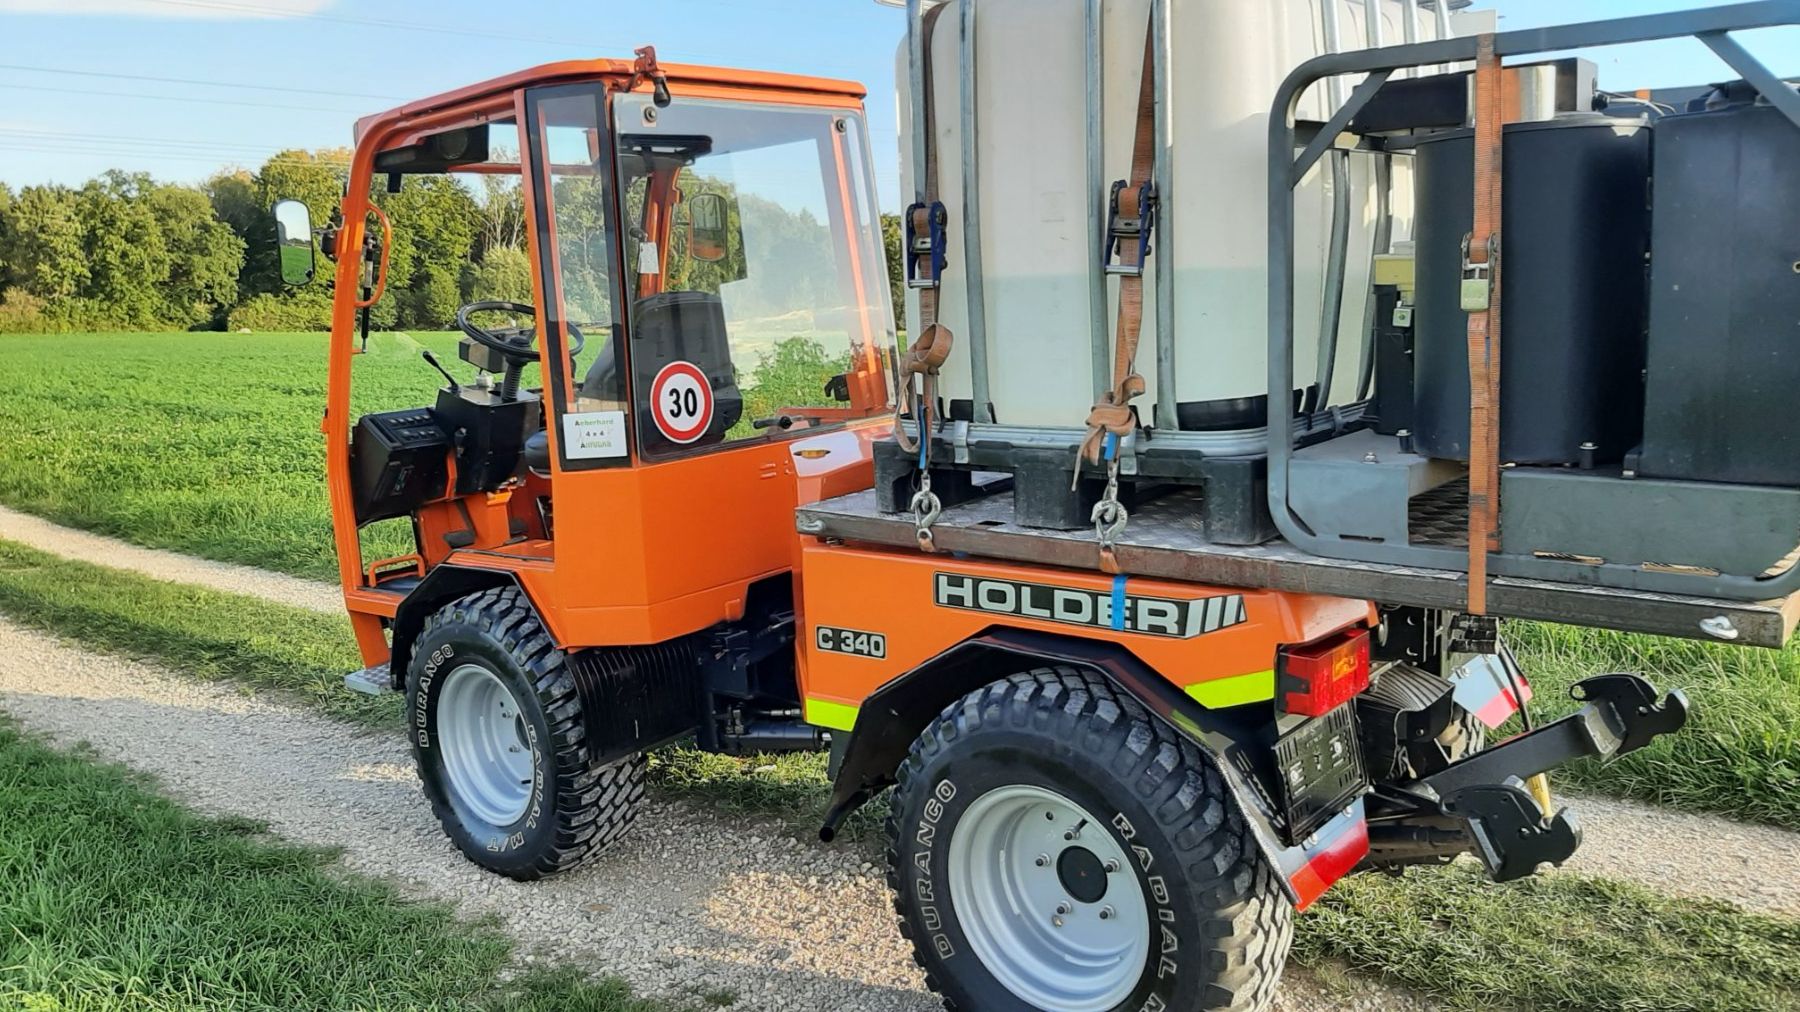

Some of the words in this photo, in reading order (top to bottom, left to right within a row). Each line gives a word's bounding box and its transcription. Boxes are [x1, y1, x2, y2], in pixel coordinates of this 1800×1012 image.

[669, 388, 698, 418] 30
[937, 575, 1179, 635] HOLDER
[818, 627, 834, 650] C
[840, 631, 884, 657] 340
[914, 779, 957, 960] DURANGO
[1111, 812, 1179, 980] RADIAL
